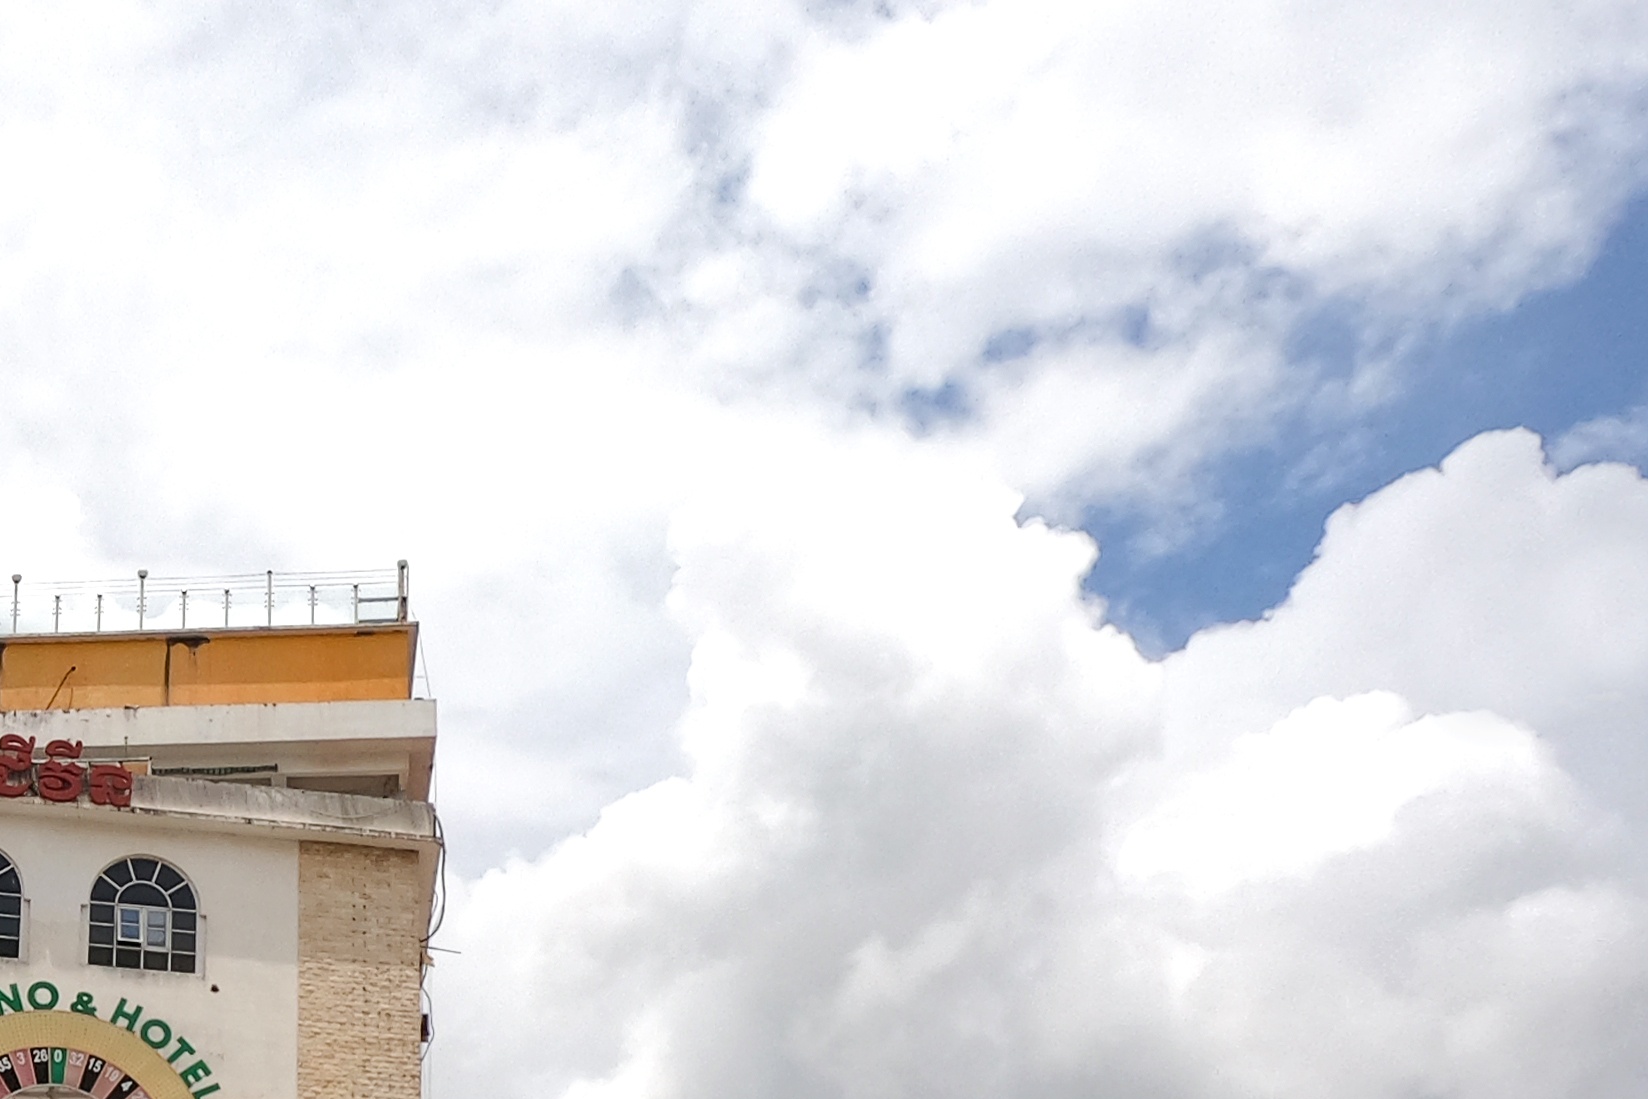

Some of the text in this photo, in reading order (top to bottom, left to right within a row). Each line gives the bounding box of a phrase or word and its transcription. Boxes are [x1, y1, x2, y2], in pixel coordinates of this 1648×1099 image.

[70, 991, 97, 1017] &
[16, 1051, 26, 1065] 3
[53, 1049, 63, 1063] 0
[88, 1057, 103, 1073] 15
[120, 1080, 133, 1092] 4
